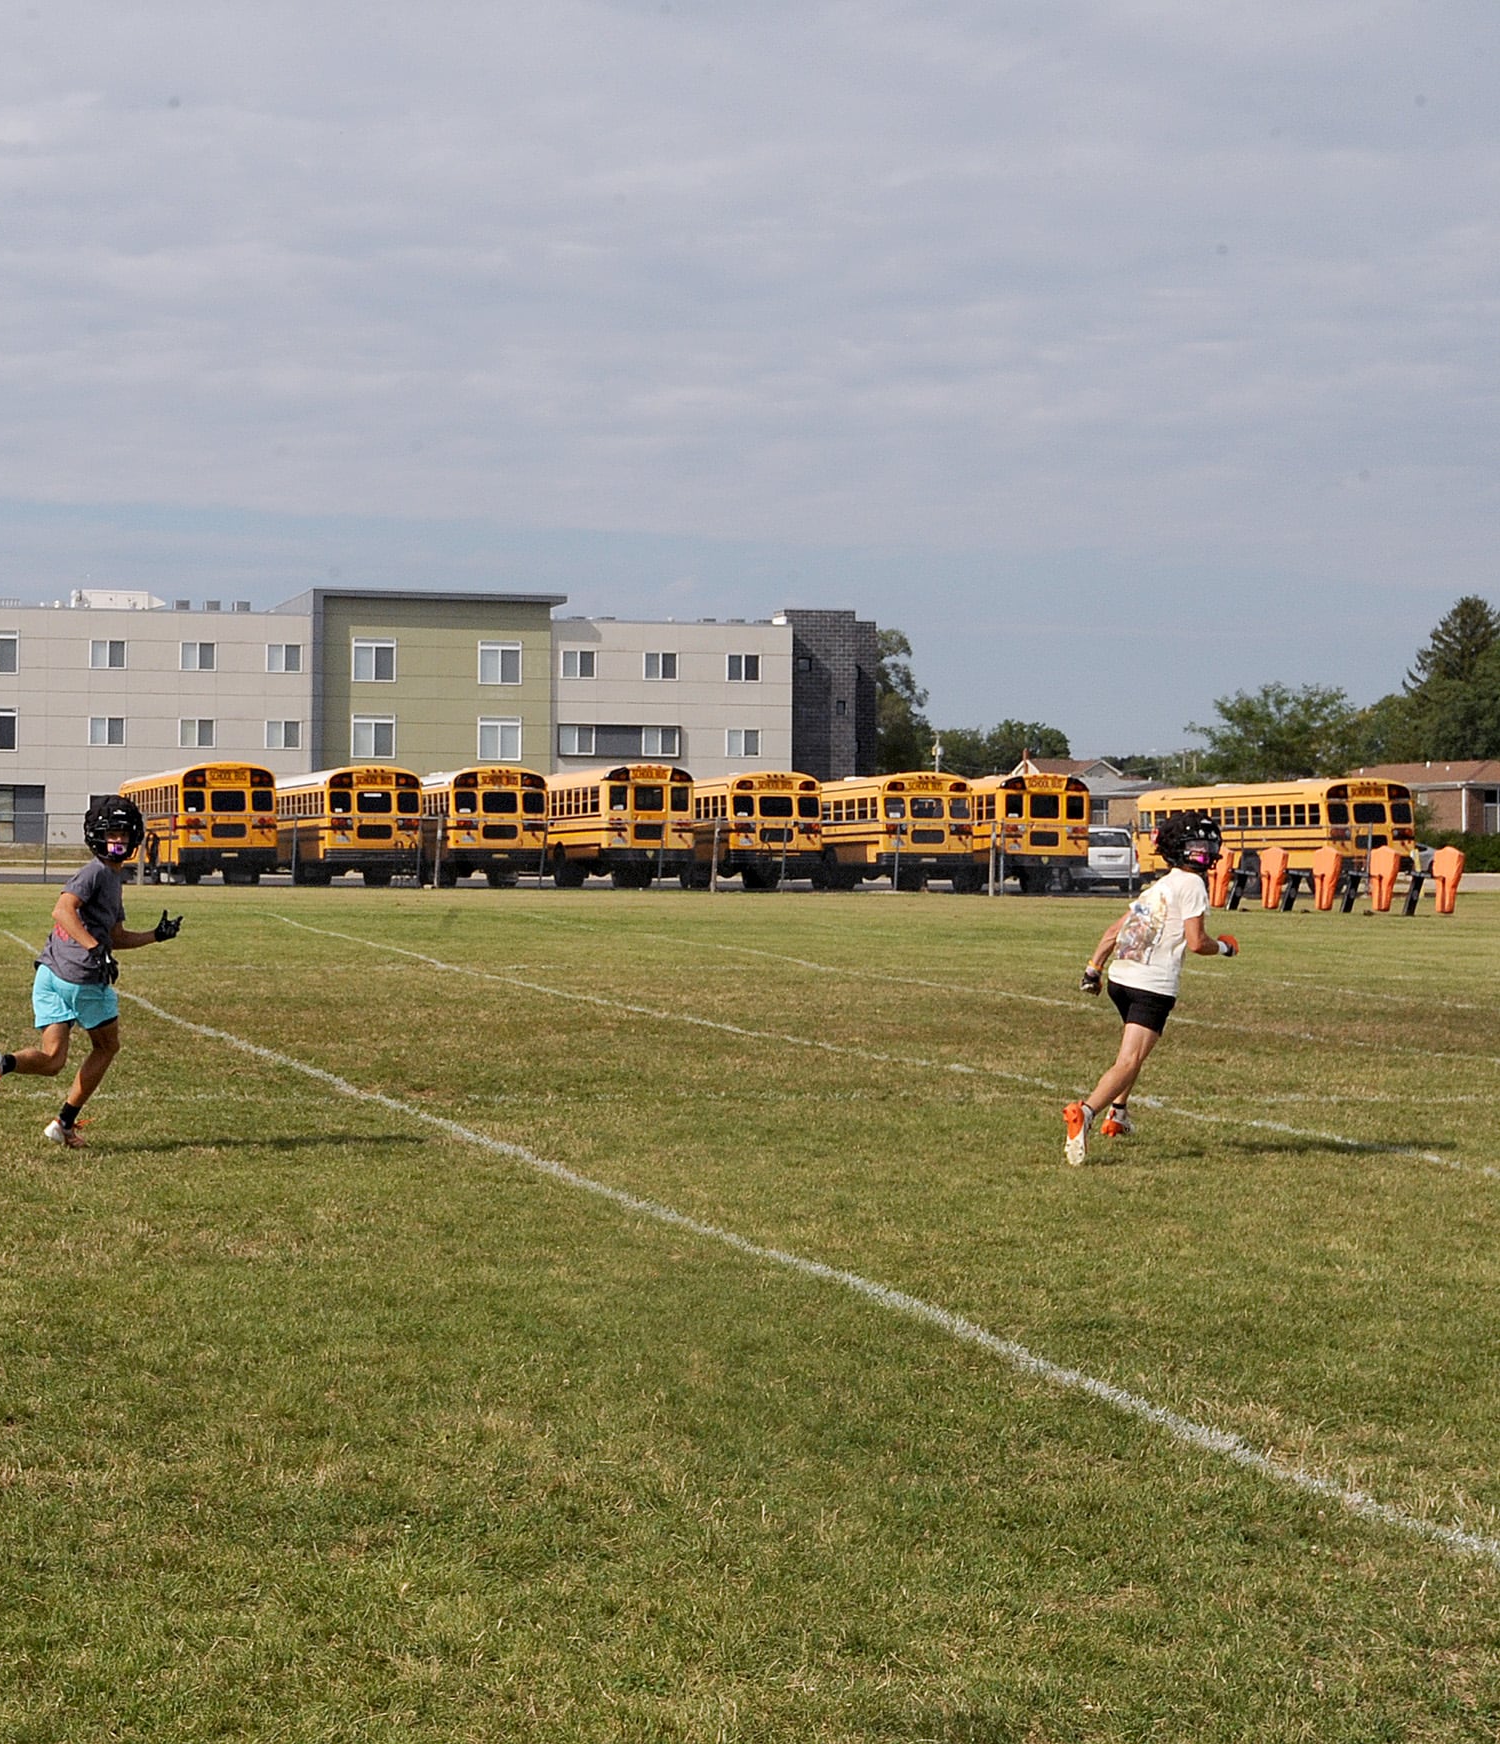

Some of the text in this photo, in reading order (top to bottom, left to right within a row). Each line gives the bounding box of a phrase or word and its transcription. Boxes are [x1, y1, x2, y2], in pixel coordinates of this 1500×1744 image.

[210, 770, 247, 781] SCHOOL BUS
[632, 769, 667, 779] SCHOOL BUS
[356, 775, 393, 785] SCHOOL BUS
[1028, 778, 1063, 788] SCHOOL BUS
[908, 781, 943, 791] SCHOOL BUS
